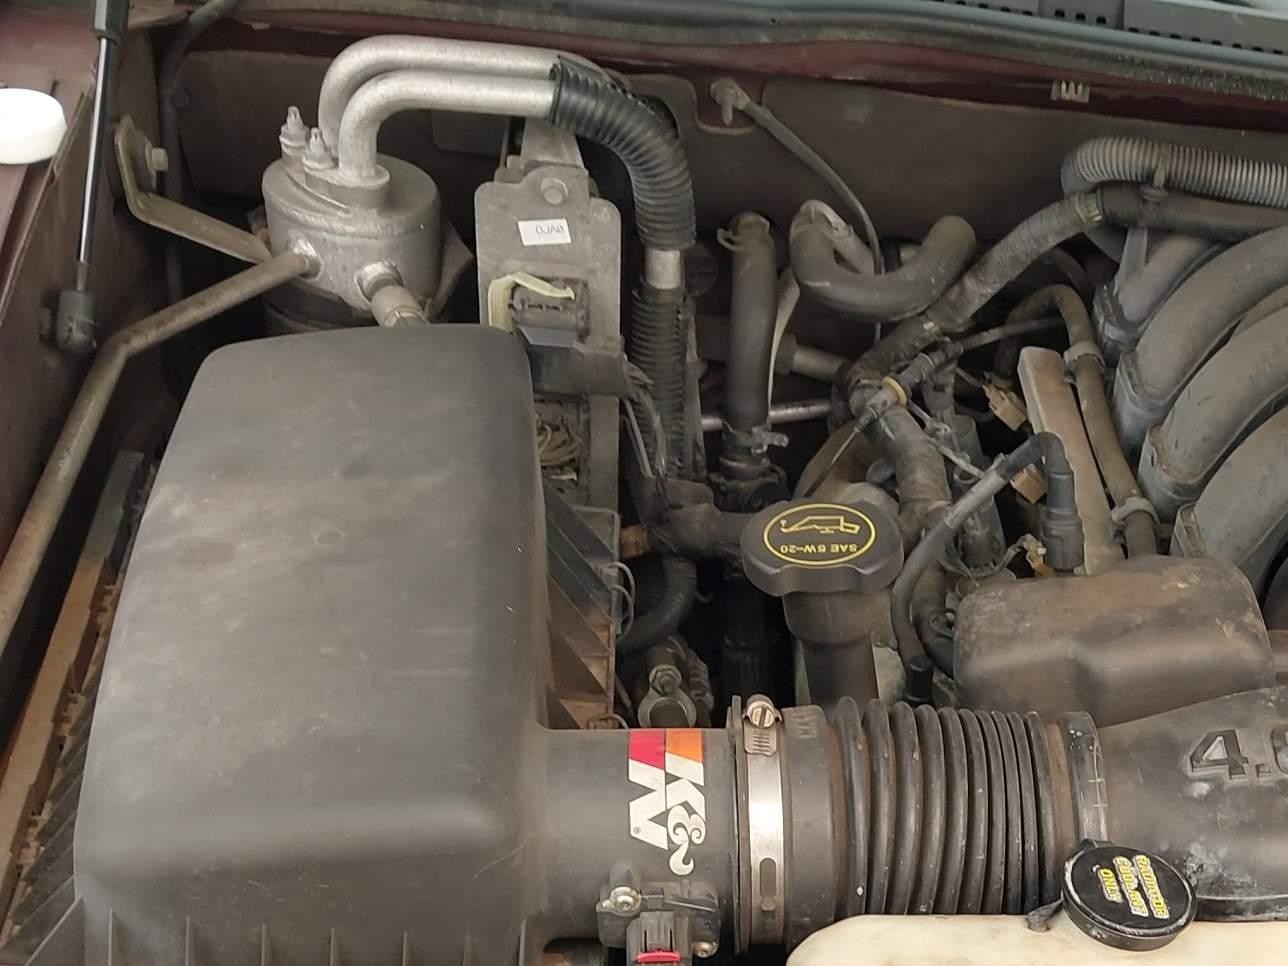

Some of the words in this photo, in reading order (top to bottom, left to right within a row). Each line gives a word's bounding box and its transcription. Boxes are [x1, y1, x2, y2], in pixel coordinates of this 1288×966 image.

[780, 543, 826, 554] 5W-20
[830, 543, 858, 554] SAE
[628, 727, 707, 876] K&N
[1097, 867, 1123, 904] ONLY
[1112, 855, 1149, 918] COOLANT
[1132, 854, 1170, 920] RADIATOR
